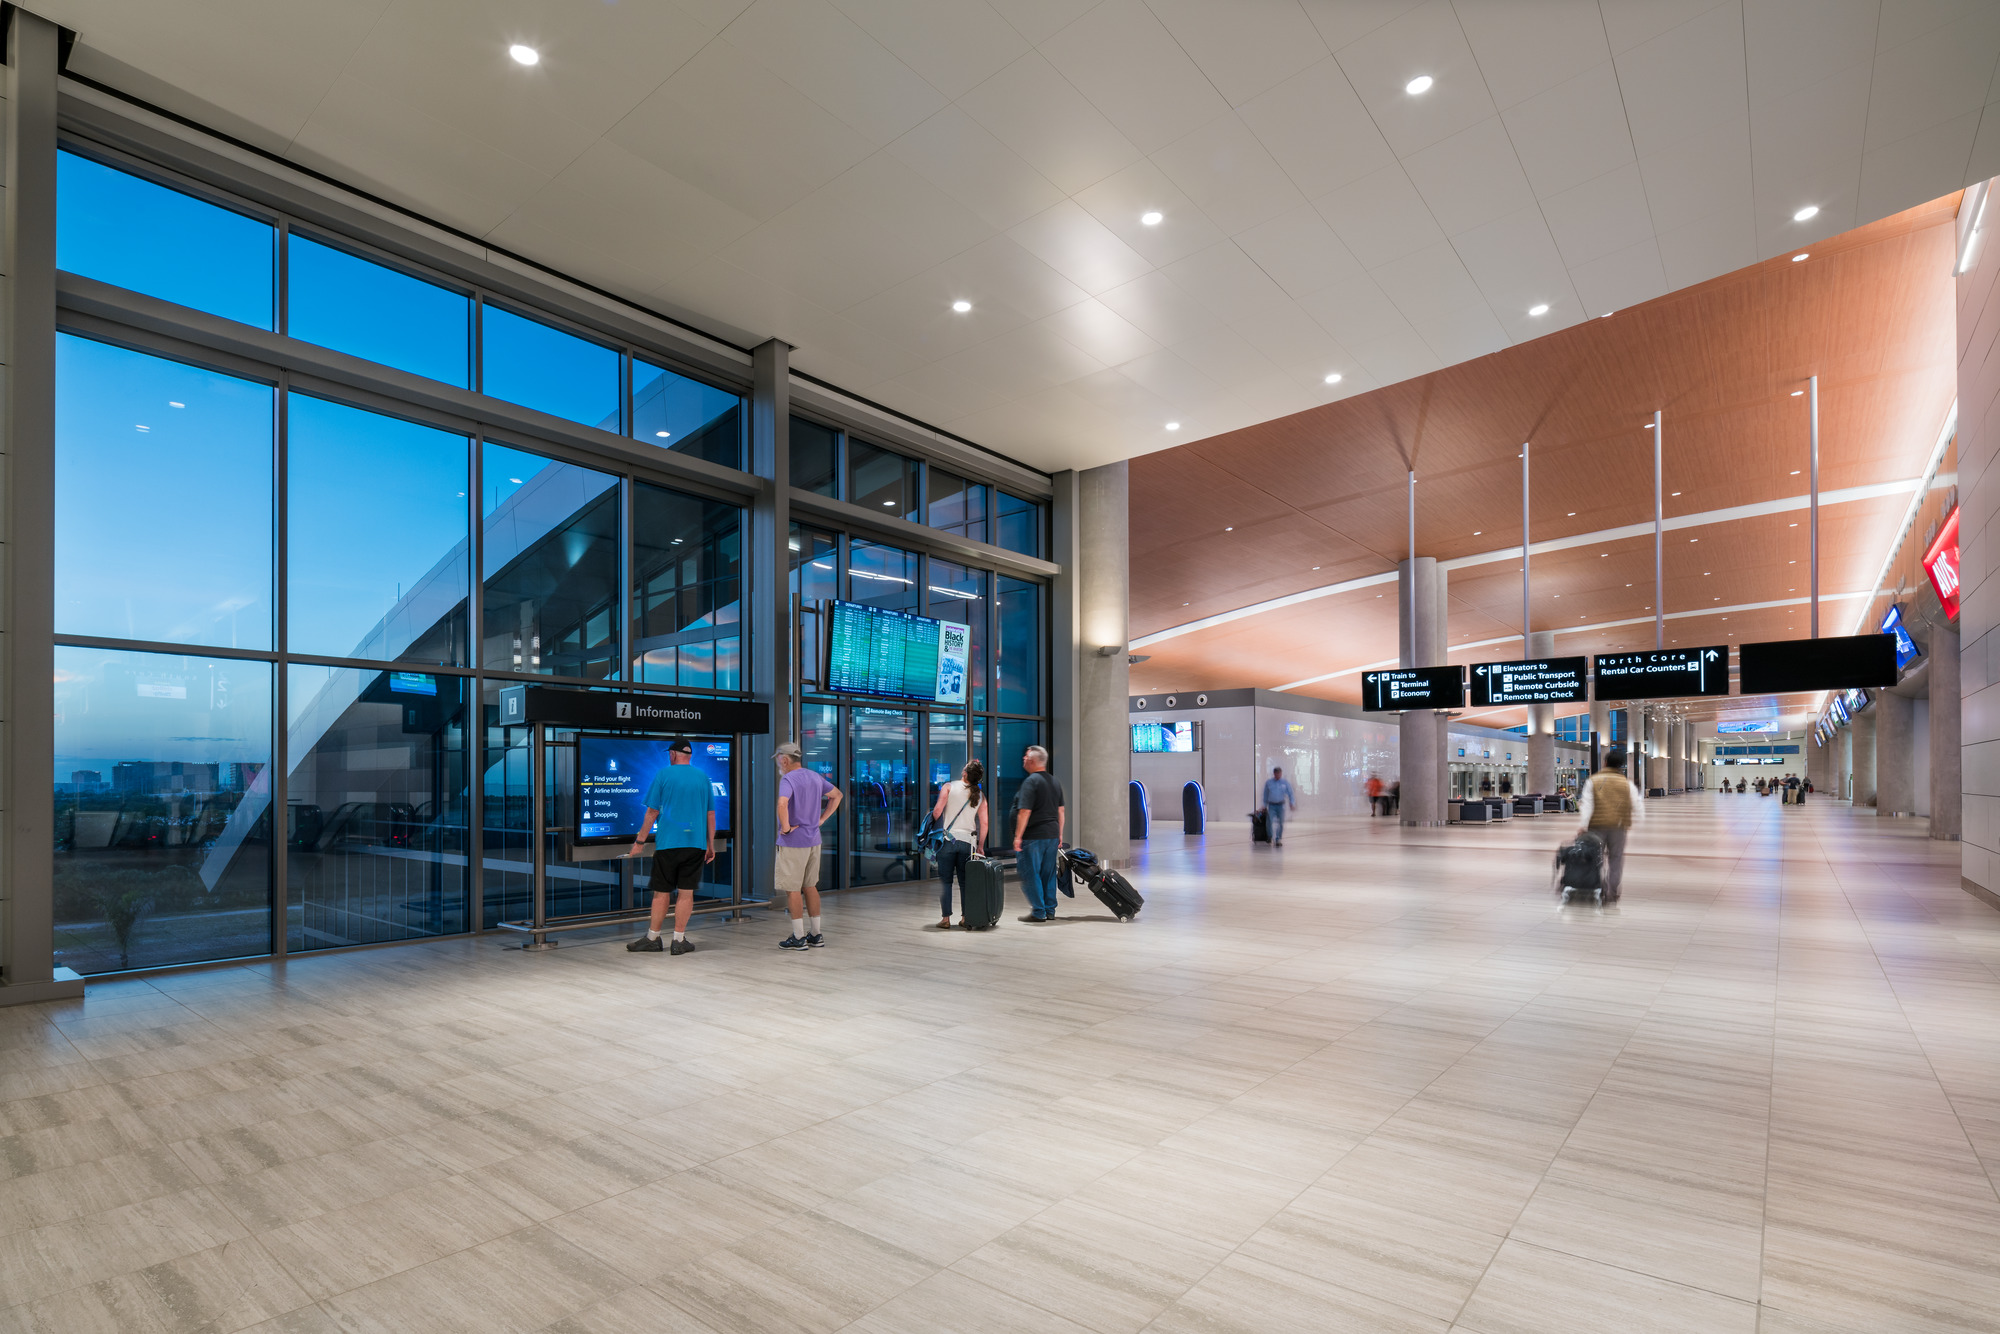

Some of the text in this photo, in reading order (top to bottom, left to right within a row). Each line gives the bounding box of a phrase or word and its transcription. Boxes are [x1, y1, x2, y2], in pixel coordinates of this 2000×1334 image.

[1932, 550, 1958, 598] AVIS
[945, 630, 964, 642] Black
[944, 639, 963, 648] HISTORY
[1599, 653, 1686, 666] North Core
[1503, 663, 1538, 672] Elevators
[1601, 664, 1686, 676] Rental Car Counters
[1514, 671, 1575, 681] Public Transport
[1514, 680, 1579, 691] Remote Curbside
[1503, 690, 1574, 700] Remote Bag Check
[635, 705, 702, 720] Information
